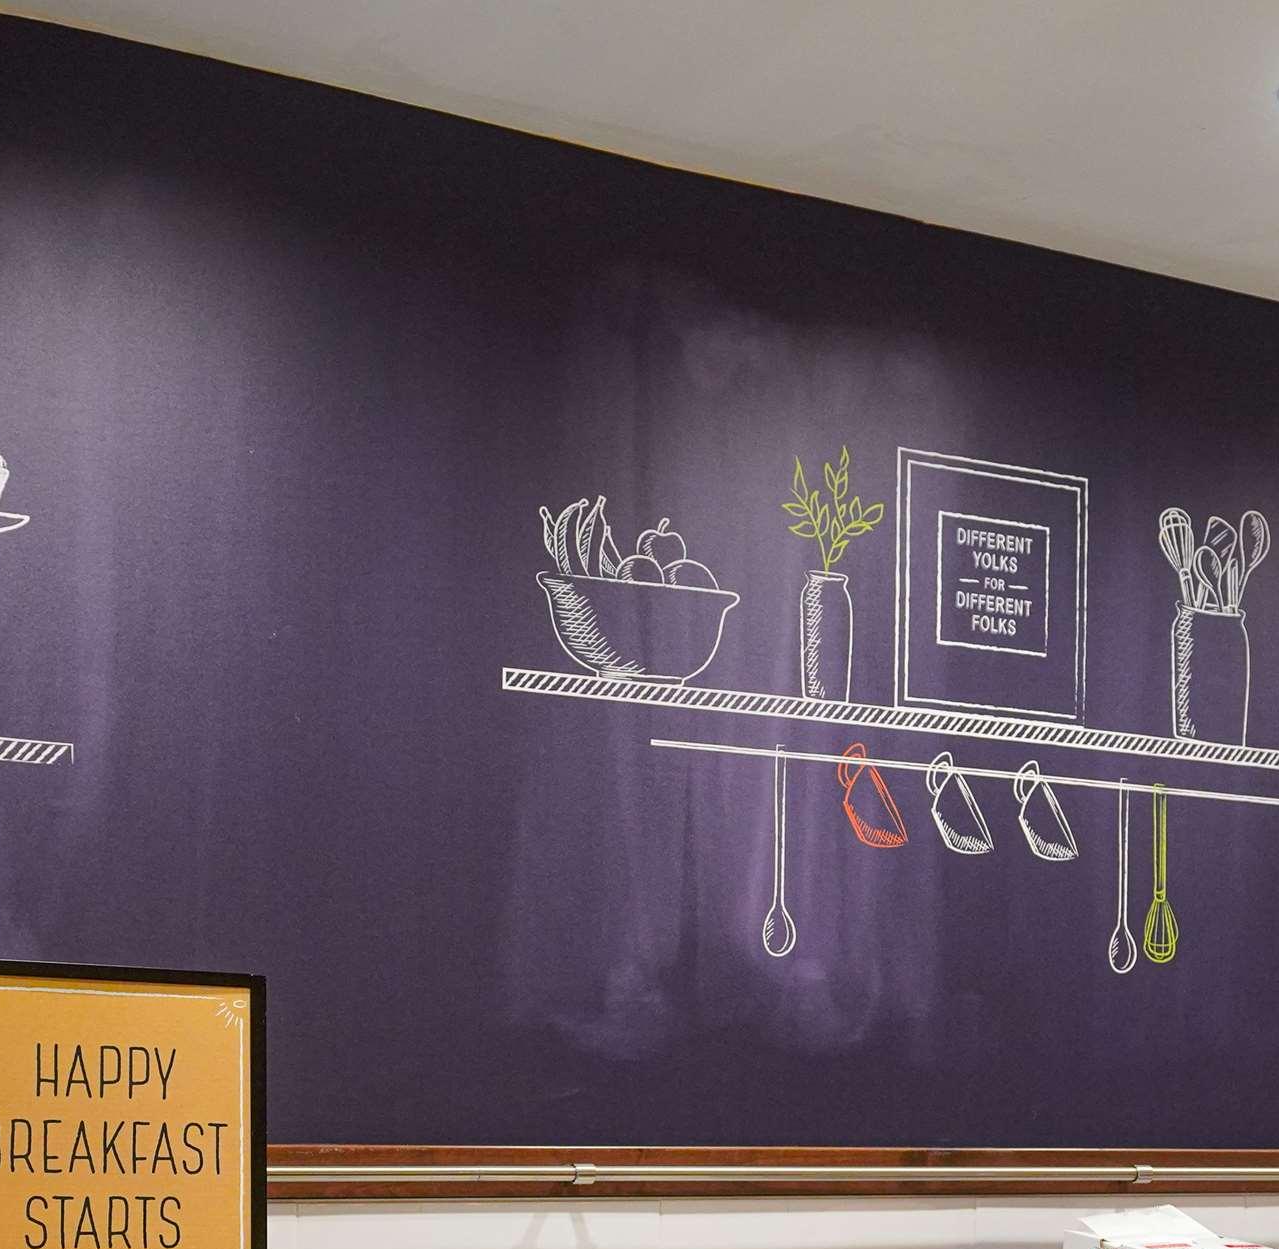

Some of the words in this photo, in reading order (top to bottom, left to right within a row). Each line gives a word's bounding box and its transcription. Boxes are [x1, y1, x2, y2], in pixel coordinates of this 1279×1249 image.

[956, 527, 1033, 555] DIFFERENT
[972, 550, 1018, 574] YOLKS
[984, 576, 1006, 591] FOR
[955, 590, 1032, 617] DIFFERENT
[971, 614, 1017, 636] FOLKS
[35, 1042, 177, 1101] HAPPY
